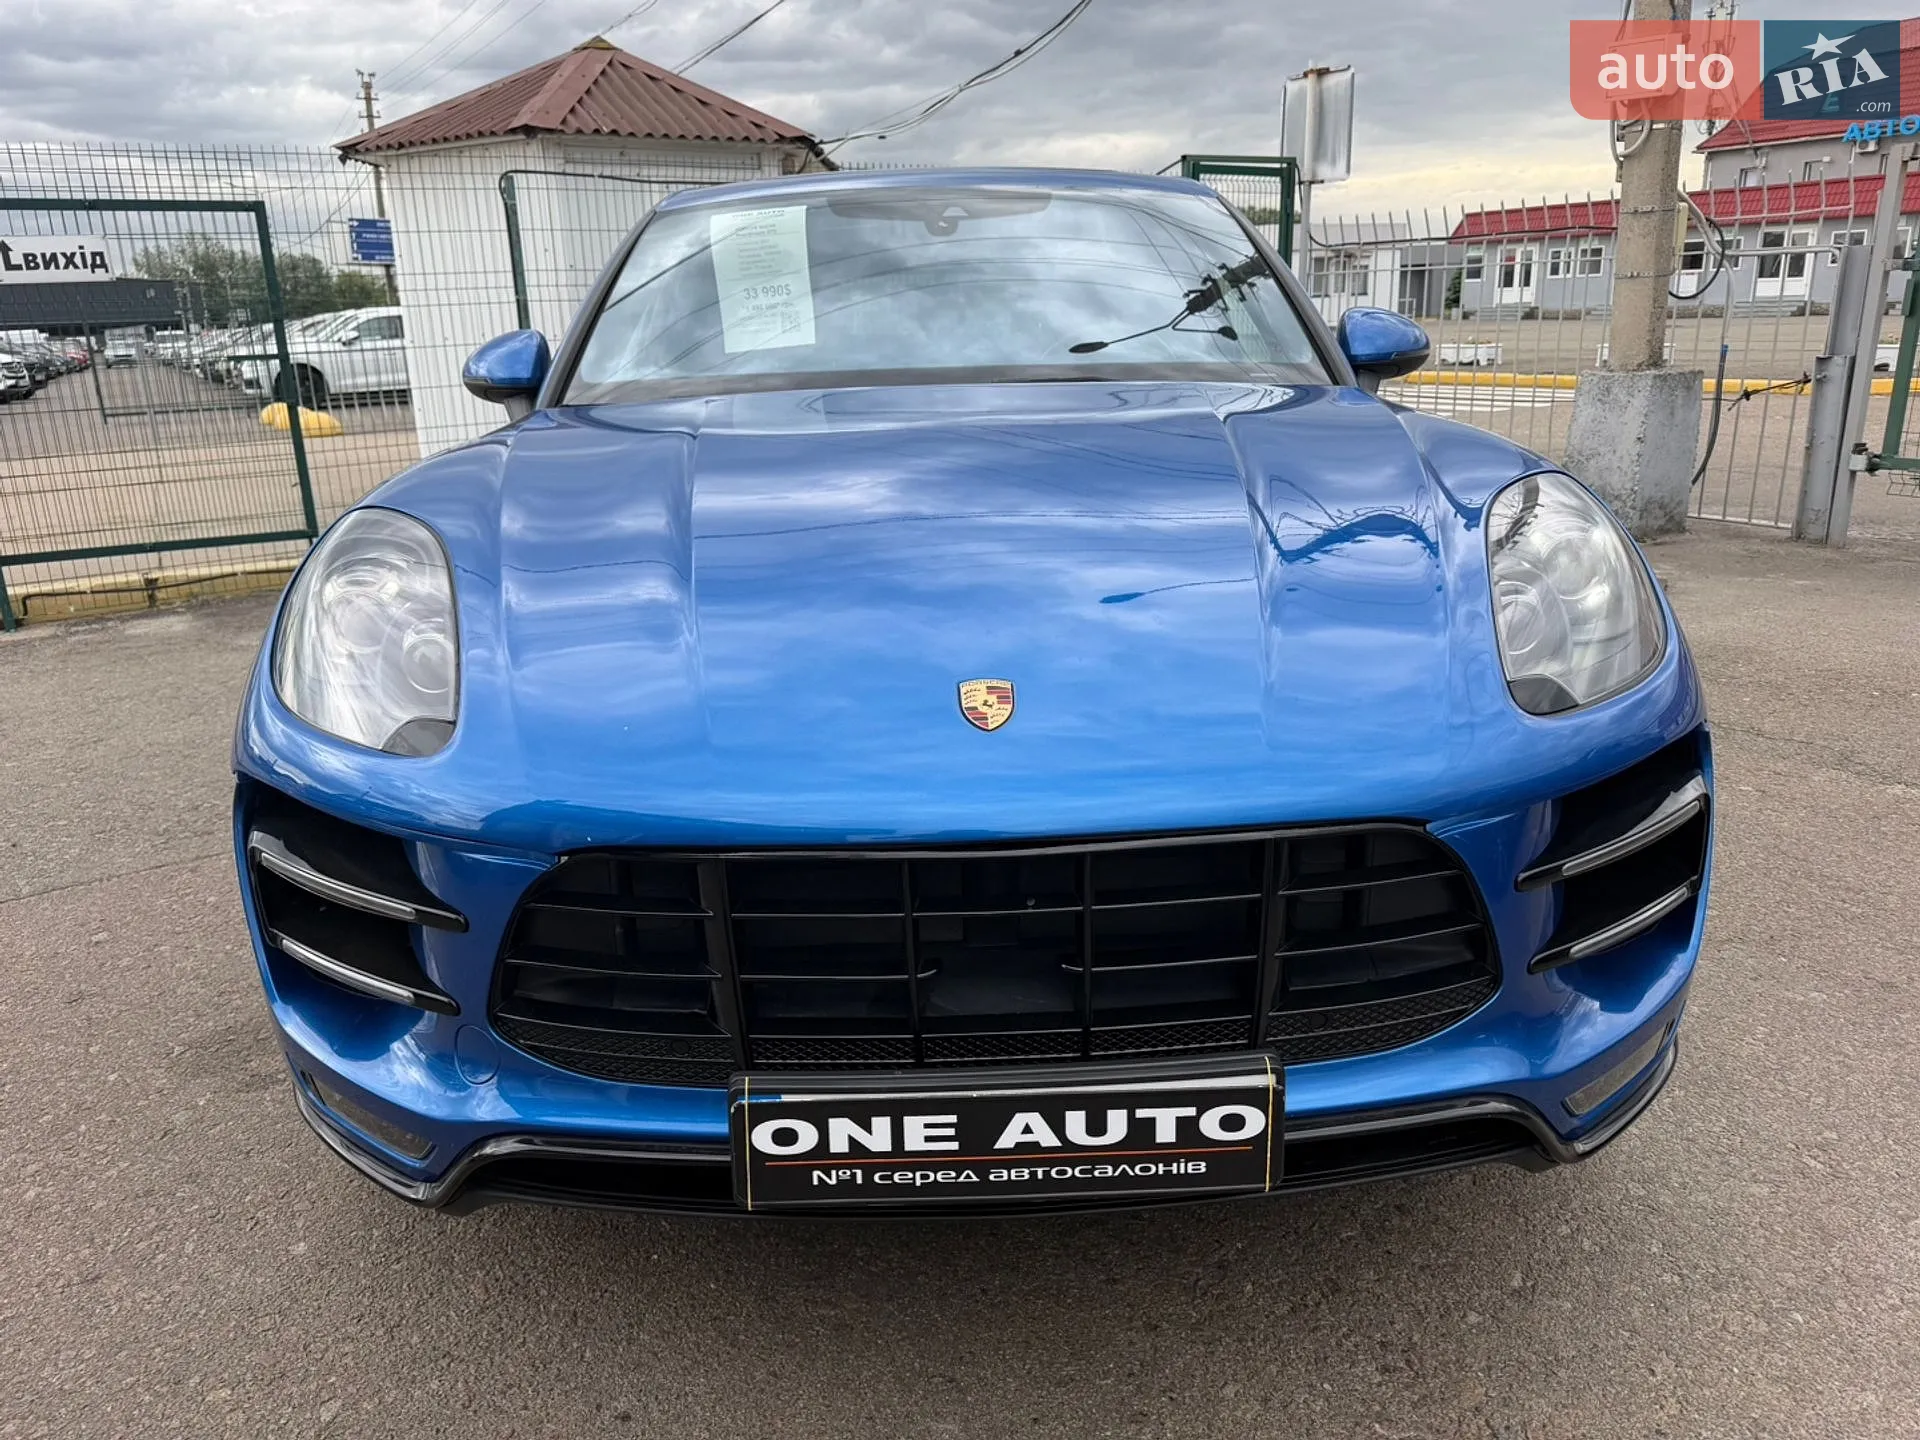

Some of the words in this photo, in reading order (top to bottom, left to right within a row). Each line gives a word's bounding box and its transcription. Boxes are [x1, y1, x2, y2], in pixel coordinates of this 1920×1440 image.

[22, 244, 110, 274] вихід
[750, 1114, 960, 1156] ONE
[993, 1104, 1267, 1149] AUTO
[873, 1168, 981, 1188] серед
